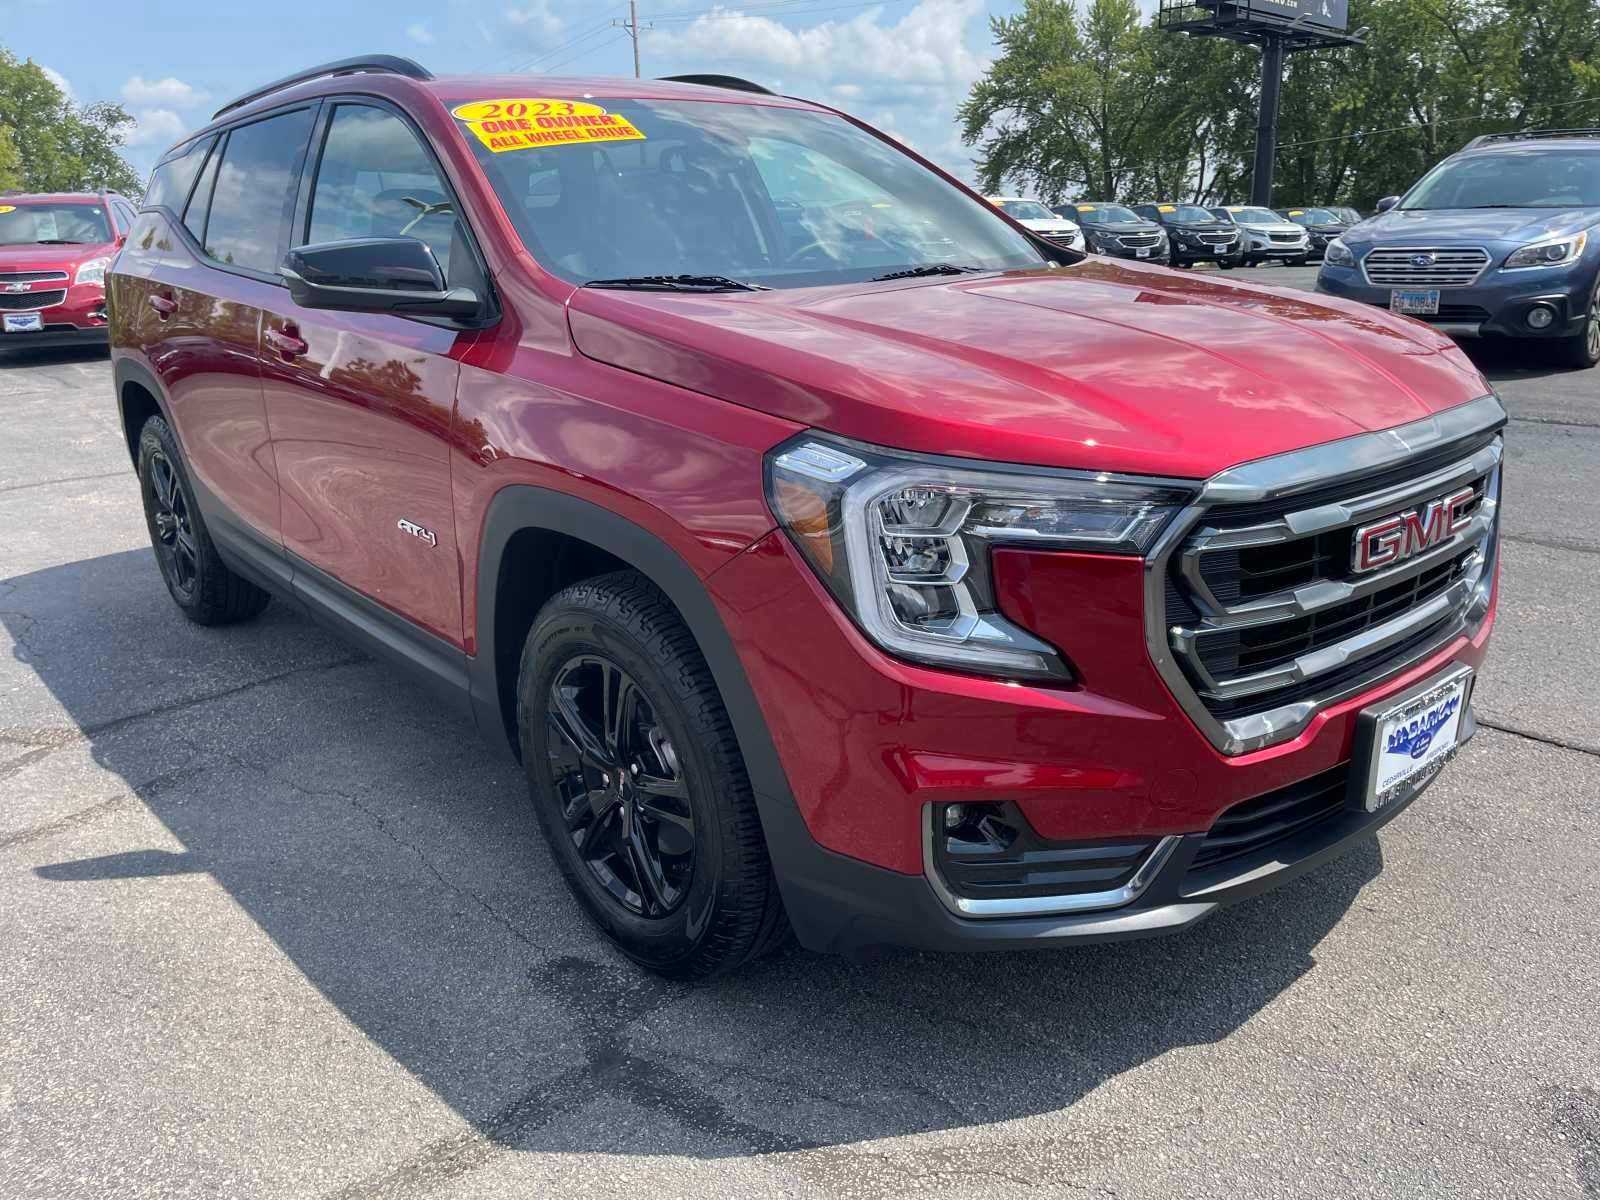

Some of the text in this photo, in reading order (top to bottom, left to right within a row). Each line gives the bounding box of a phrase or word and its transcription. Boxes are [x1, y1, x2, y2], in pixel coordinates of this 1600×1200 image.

[483, 102, 577, 119] 2023
[481, 113, 617, 134] ONE OWNER
[490, 126, 638, 149] ALL WHEEL DRIVE
[1354, 487, 1474, 573] GMC
